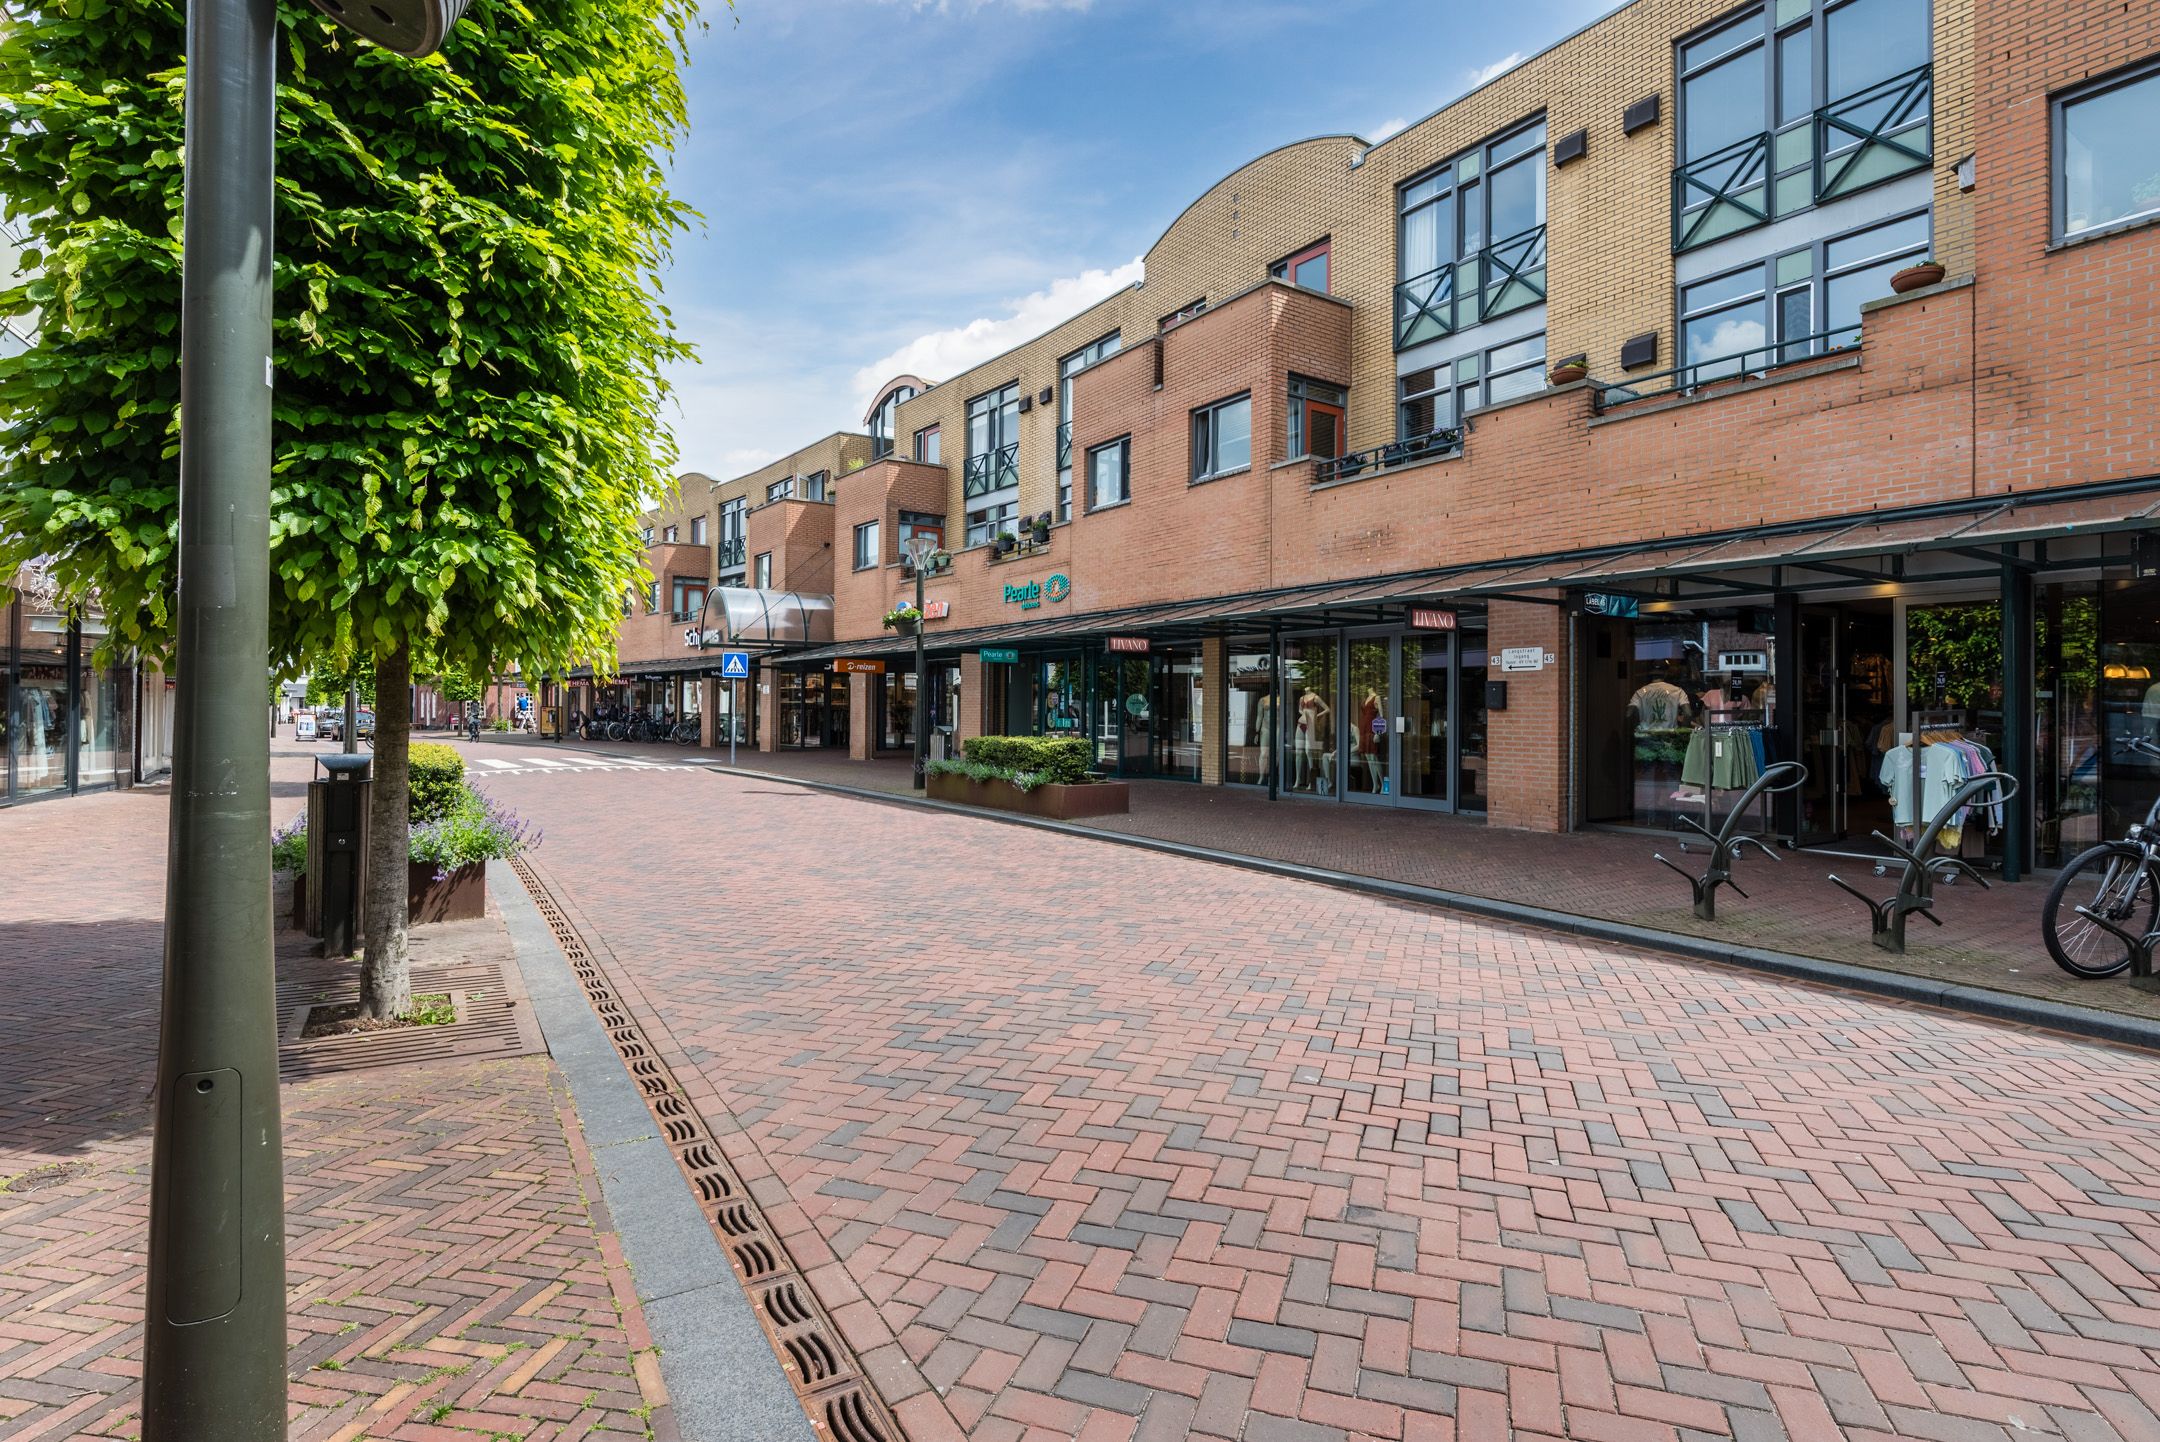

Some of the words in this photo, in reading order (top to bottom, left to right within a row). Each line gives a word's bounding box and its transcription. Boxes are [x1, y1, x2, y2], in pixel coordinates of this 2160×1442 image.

[1003, 580, 1040, 603] Pearle
[1415, 612, 1454, 628] LIVANO
[1112, 639, 1147, 651] LIVANO
[983, 650, 1003, 658] Pearle
[1544, 654, 1554, 663] 45
[847, 661, 876, 671] D-reizen
[1492, 657, 1500, 665] 43
